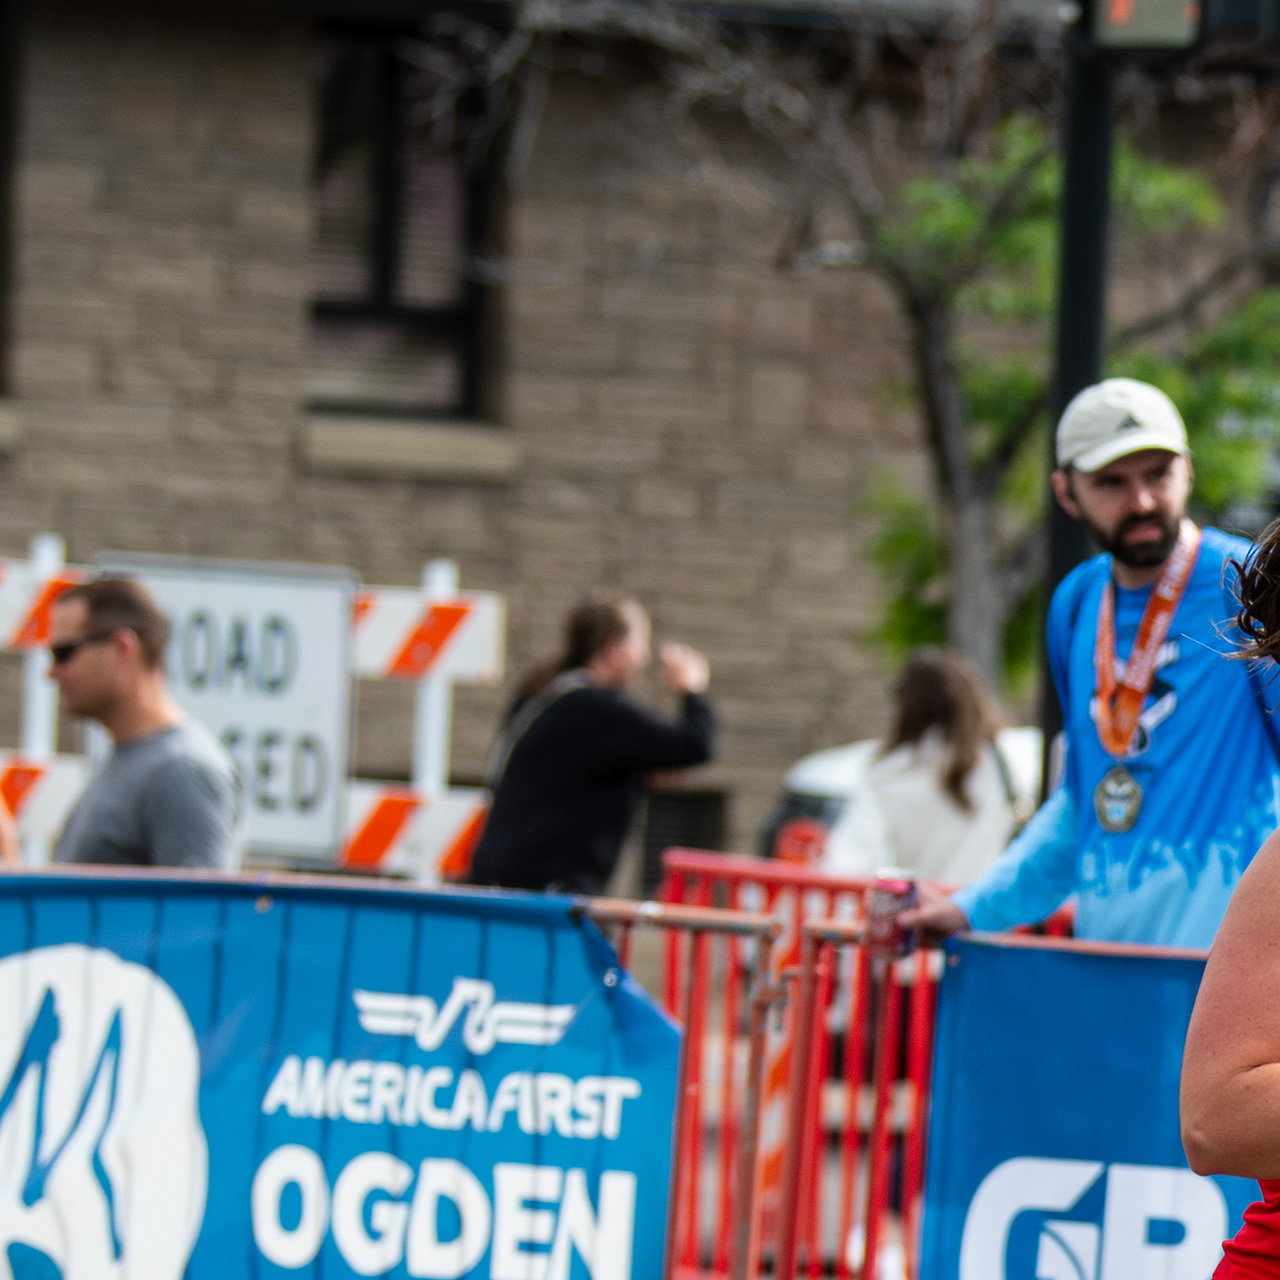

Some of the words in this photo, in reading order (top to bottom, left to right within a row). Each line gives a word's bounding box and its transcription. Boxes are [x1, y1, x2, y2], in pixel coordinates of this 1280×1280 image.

[180, 610, 297, 696] OAD
[261, 1055, 487, 1132] AMERICA
[485, 1070, 641, 1140] FIRST
